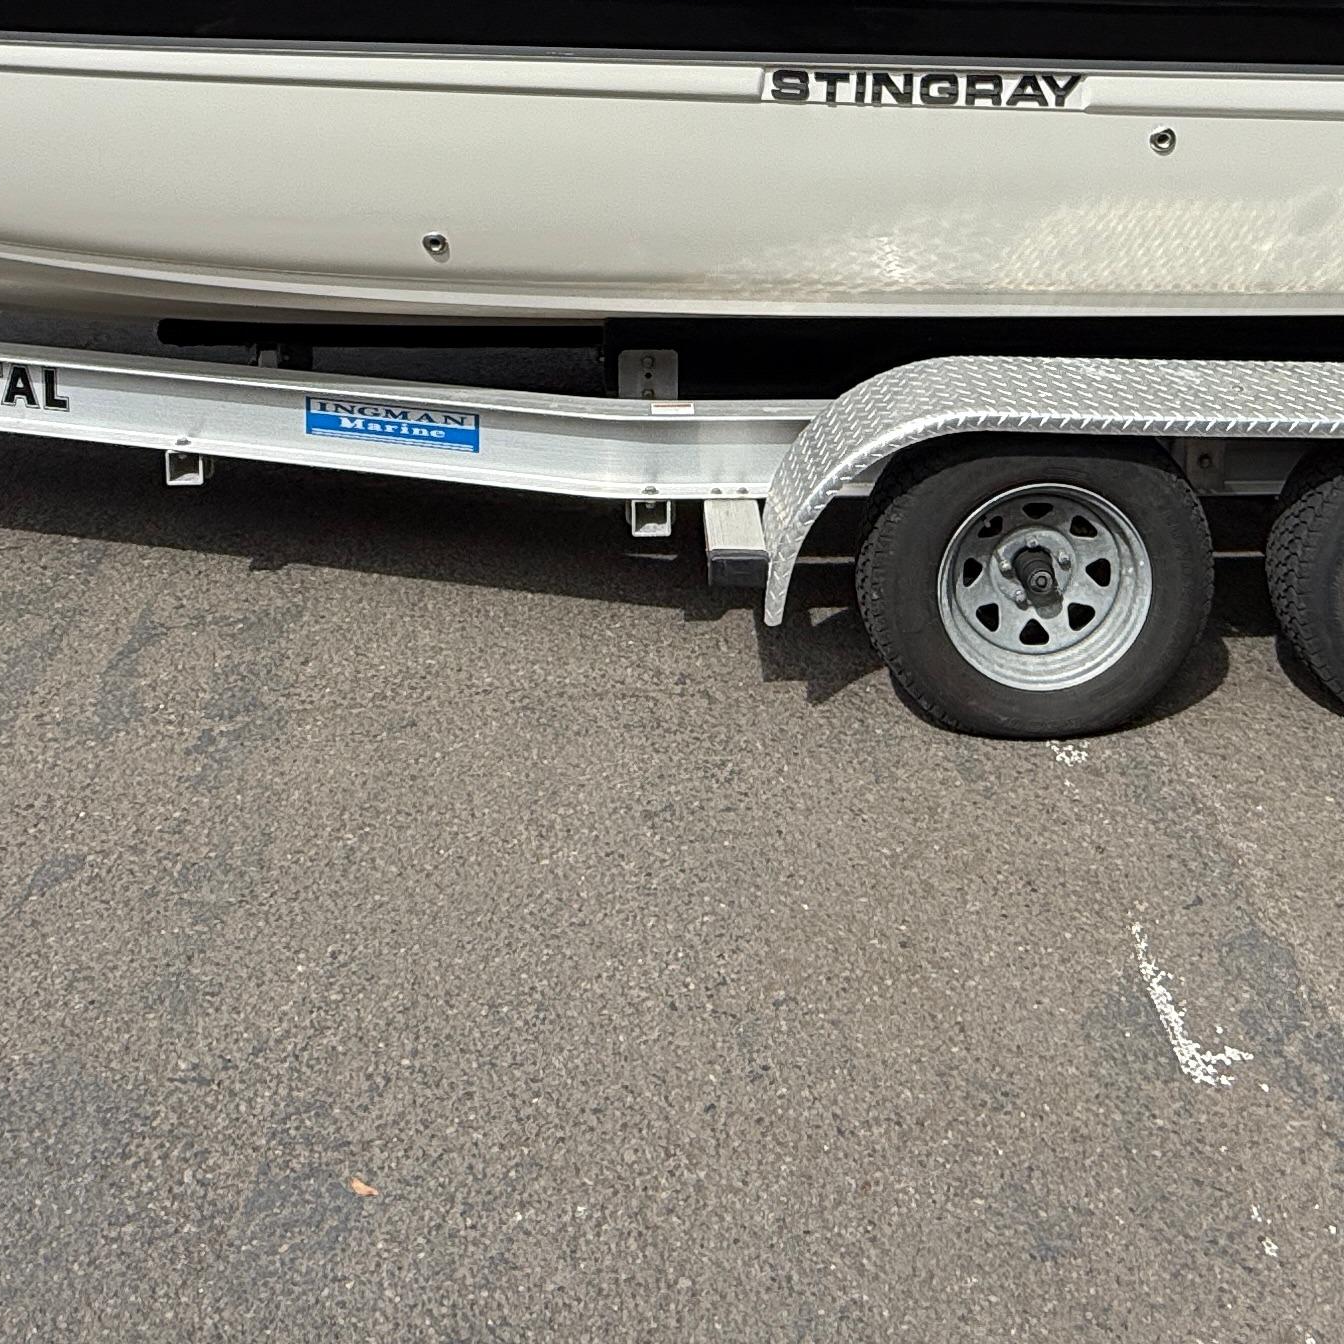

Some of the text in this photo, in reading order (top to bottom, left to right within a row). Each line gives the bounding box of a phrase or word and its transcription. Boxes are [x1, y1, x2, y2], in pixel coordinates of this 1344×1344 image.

[771, 68, 1083, 107] STINGRAY
[317, 401, 467, 426] INGMAN
[339, 416, 447, 439] Marine
